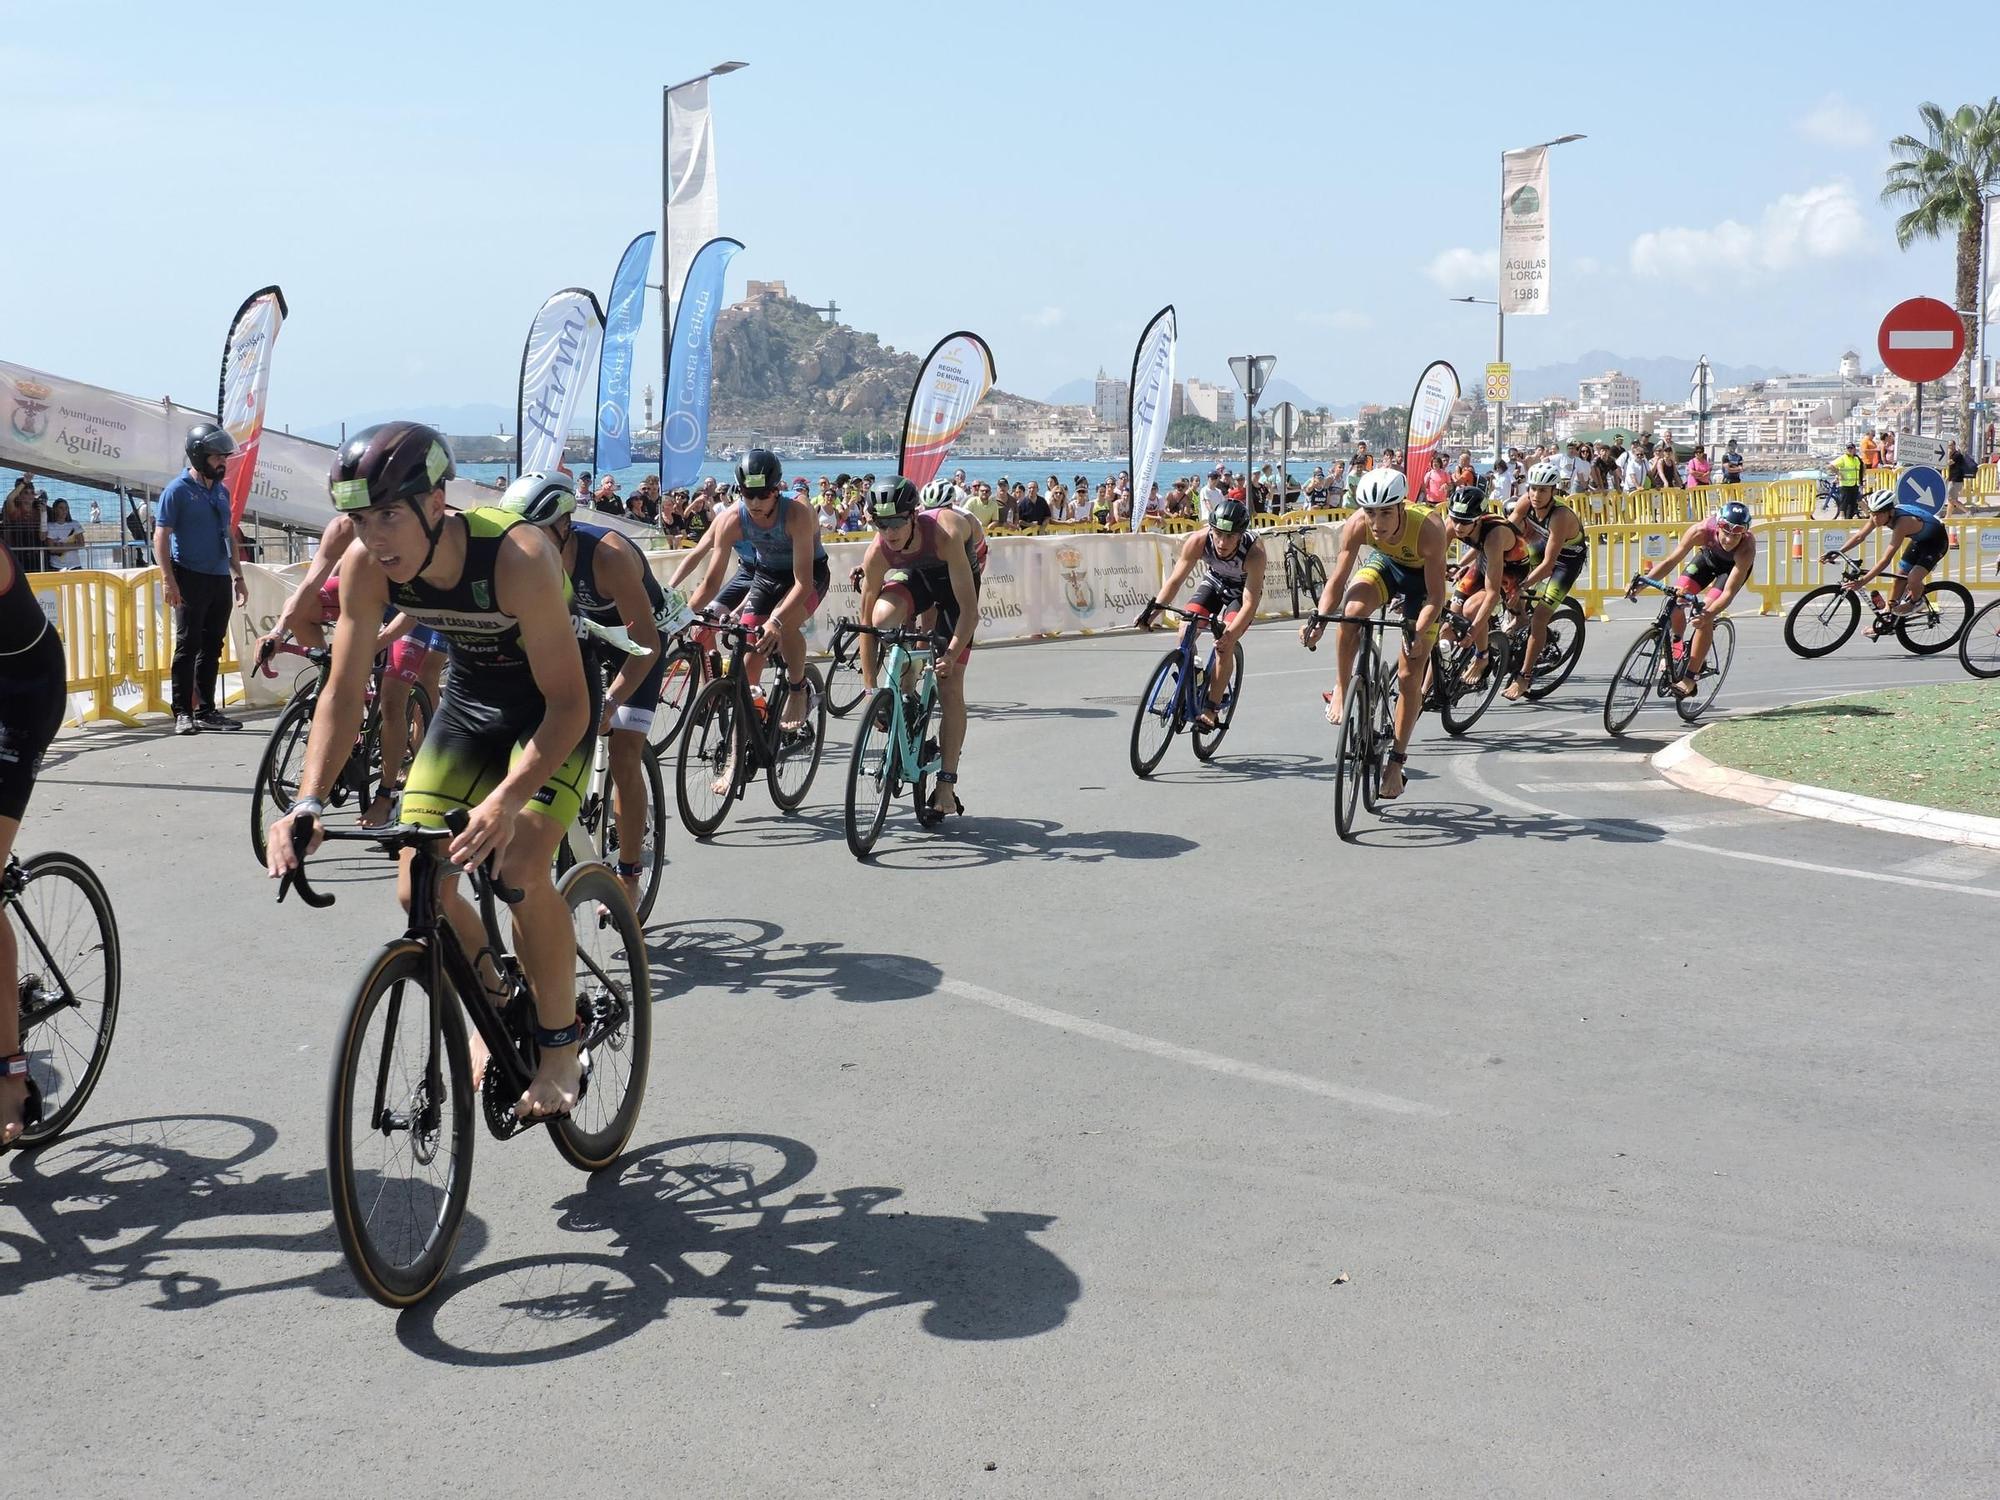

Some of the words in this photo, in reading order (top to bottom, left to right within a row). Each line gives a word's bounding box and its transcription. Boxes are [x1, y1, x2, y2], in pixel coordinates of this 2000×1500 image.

[1510, 271, 1542, 281] LORCA
[1513, 288, 1539, 300] 1988
[938, 363, 962, 375] REGIÓN
[680, 353, 699, 405] Costa
[936, 371, 945, 379] DE
[945, 374, 970, 385] MURCIA
[58, 406, 127, 431] Ayuntamiento
[85, 424, 97, 436] de
[56, 427, 121, 459] Águilas
[250, 477, 288, 501] uilas
[1093, 564, 1143, 580] Ayuntamiento
[1118, 577, 1128, 588] de
[986, 588, 997, 600] de
[1103, 587, 1150, 614] Águilas
[846, 595, 856, 608] de
